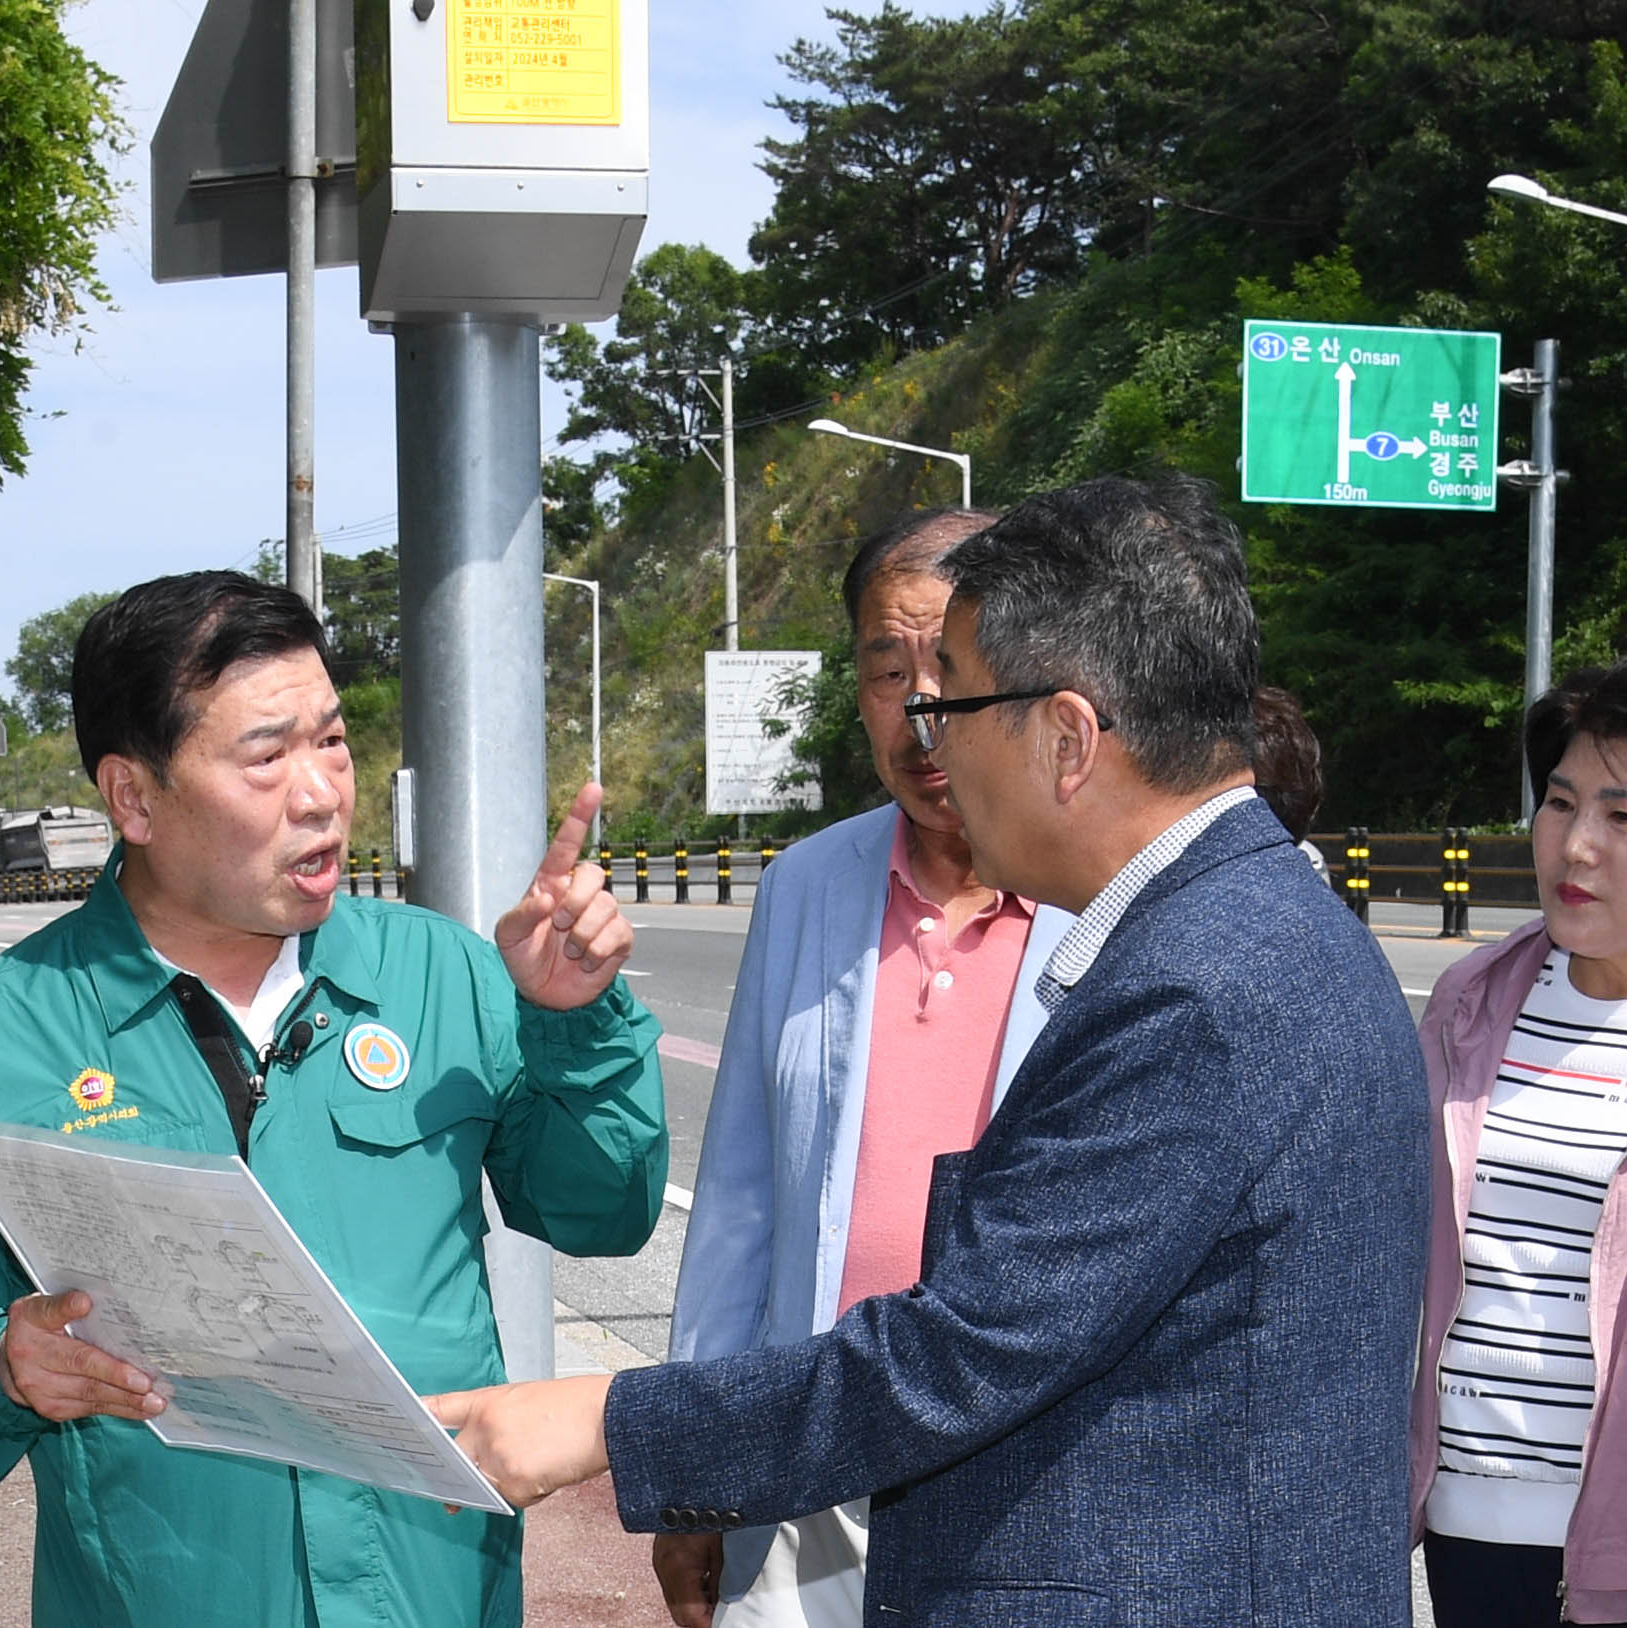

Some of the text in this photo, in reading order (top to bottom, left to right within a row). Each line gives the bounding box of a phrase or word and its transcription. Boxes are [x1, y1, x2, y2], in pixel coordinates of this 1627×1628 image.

[510, 16, 570, 32] 교통관리센터
[464, 51, 503, 65] 설치일자
[512, 52, 568, 67] 2024년 4월
[463, 73, 504, 88] 관리번호
[1258, 336, 1400, 367] 31 온산 Onsan
[1429, 402, 1479, 428] 부산
[1376, 438, 1389, 456] 7
[1429, 430, 1479, 447] Busan
[1429, 453, 1479, 478] 경주
[1324, 484, 1368, 501] 150m
[1428, 480, 1492, 499] Gyeongju
